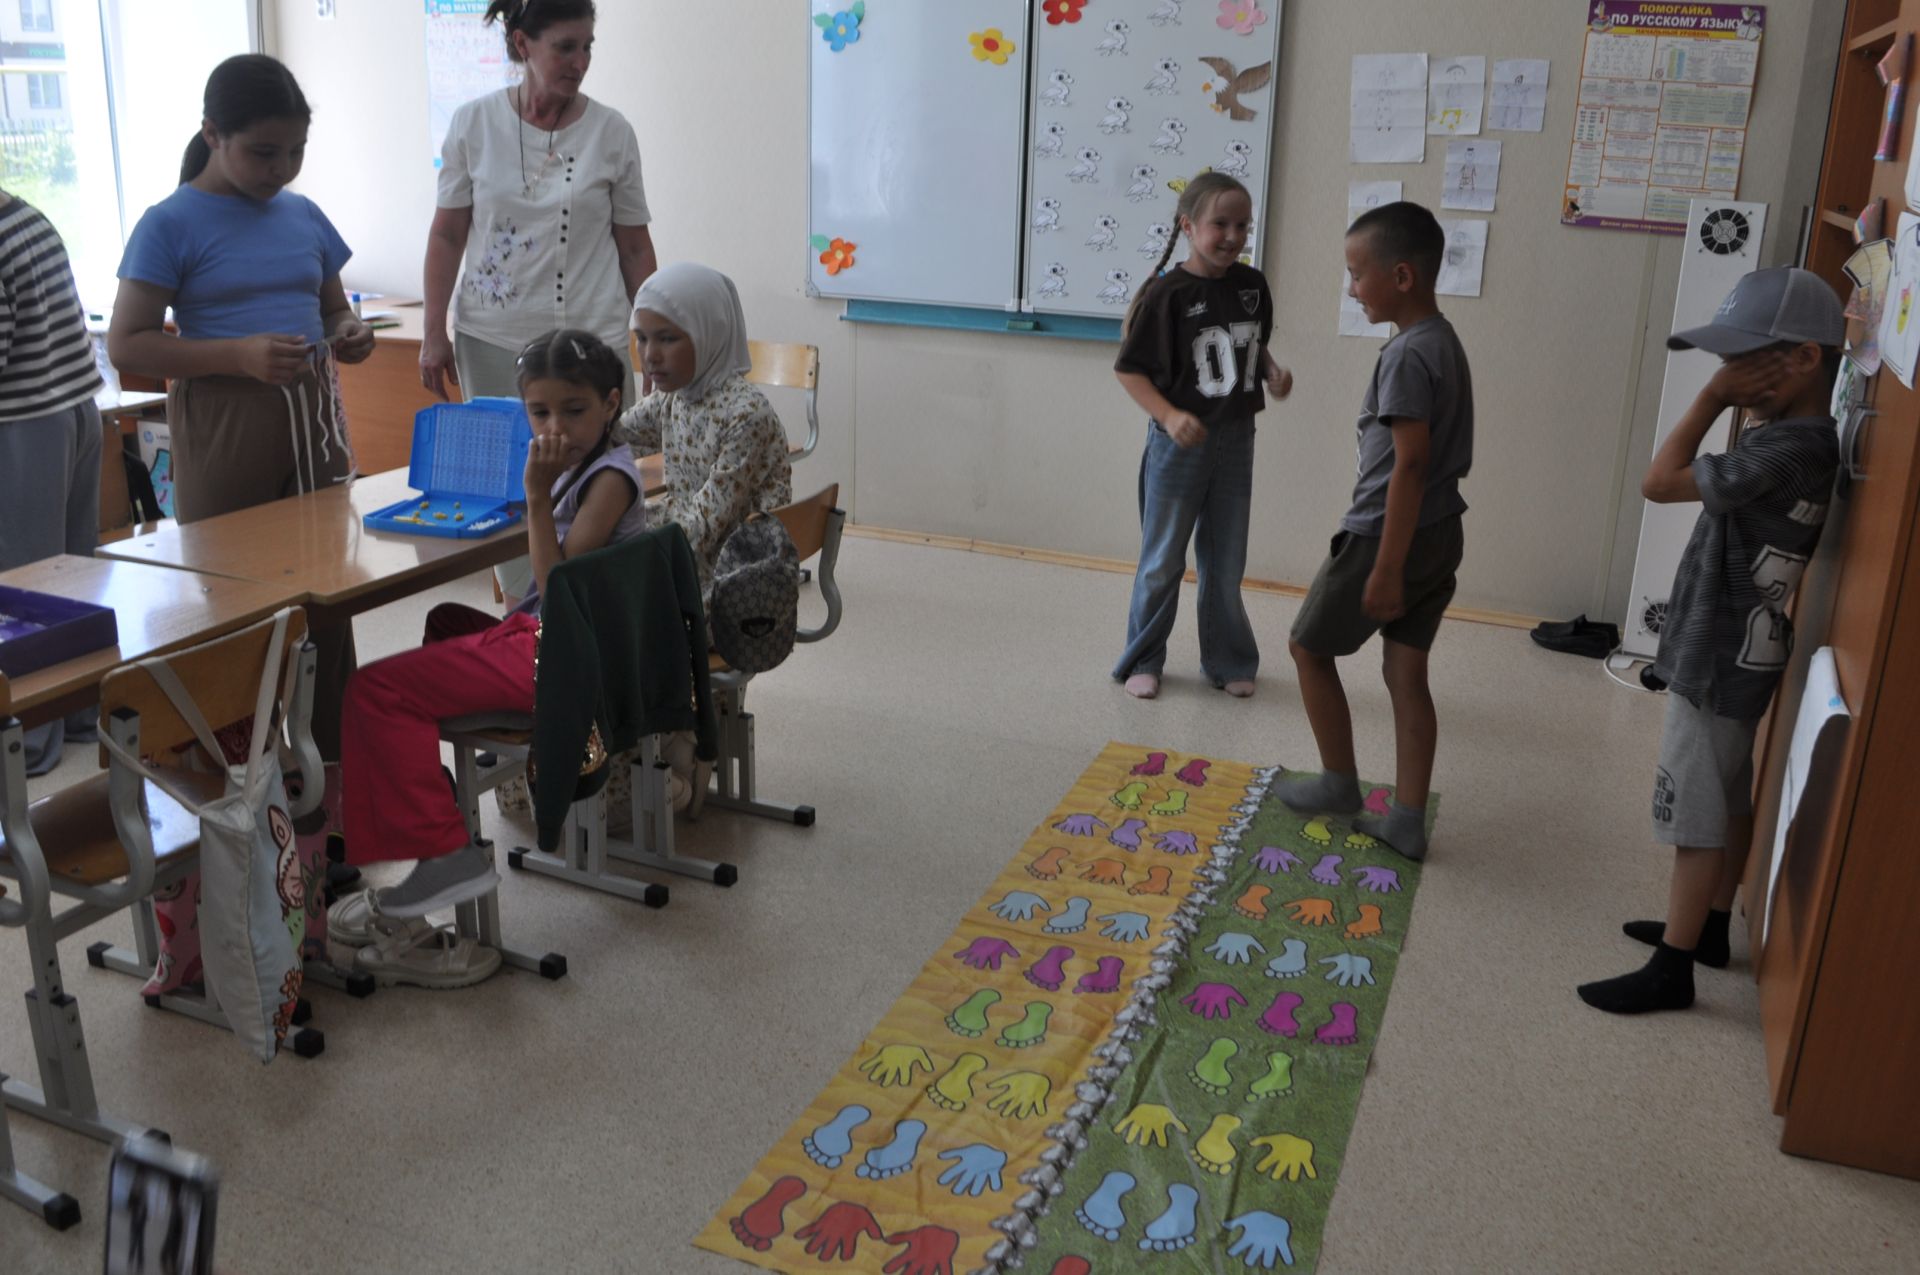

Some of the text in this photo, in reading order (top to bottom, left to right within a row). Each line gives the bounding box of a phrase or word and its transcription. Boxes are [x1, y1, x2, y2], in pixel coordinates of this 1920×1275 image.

[1639, 4, 1713, 15] ПОМОГАЙКА
[1611, 13, 1744, 30] ПО РУССКОМУ ЯЗЫКУ
[1192, 320, 1261, 398] 07
